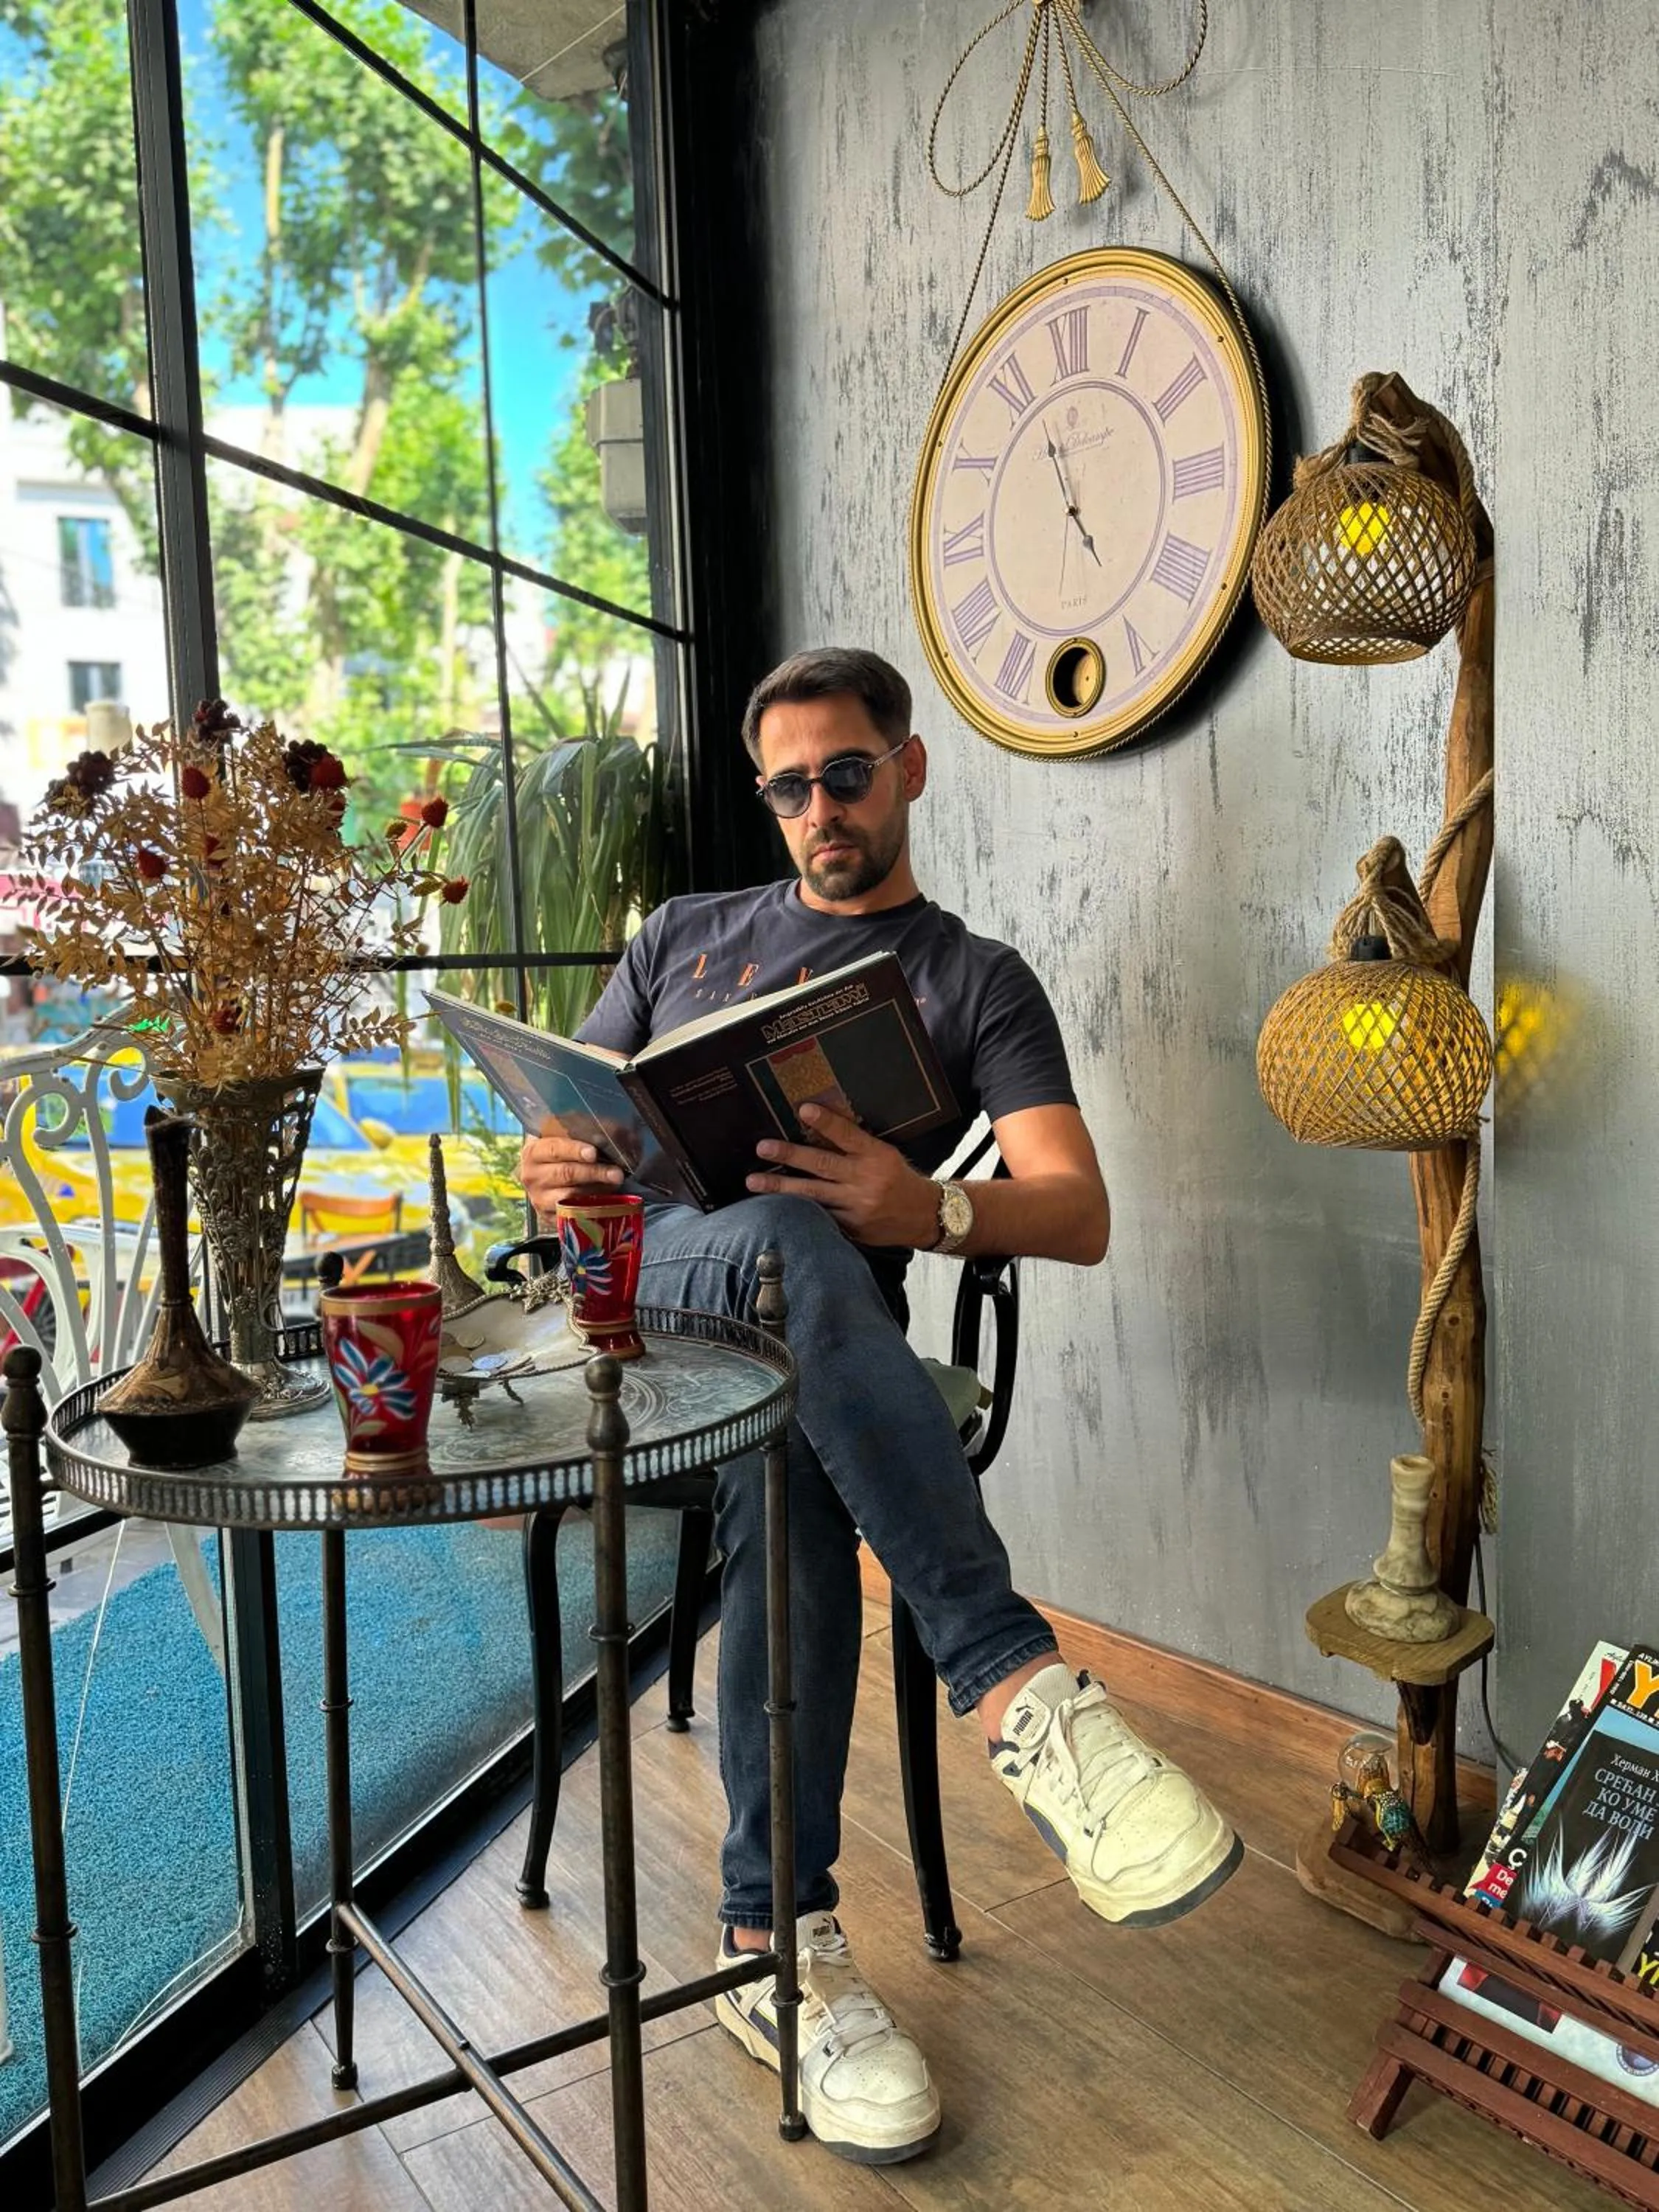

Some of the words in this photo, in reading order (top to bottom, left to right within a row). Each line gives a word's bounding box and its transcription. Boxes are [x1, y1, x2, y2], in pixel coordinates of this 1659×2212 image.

[1046, 305, 1091, 387] XII
[1115, 307, 1150, 379] I
[986, 349, 1038, 431] XI
[1151, 351, 1208, 428] II
[952, 437, 998, 487] X
[1172, 442, 1225, 504] III
[944, 509, 985, 568] IX
[951, 575, 1003, 664] VIII
[1122, 613, 1160, 678] V
[995, 629, 1037, 706] VII
[1012, 1709, 1034, 1736] PUMA
[1610, 1753, 1651, 1778] Херман
[1582, 1800, 1607, 1821] ДА
[1597, 1787, 1621, 1806] КО
[1621, 1797, 1658, 1823] УМЕ
